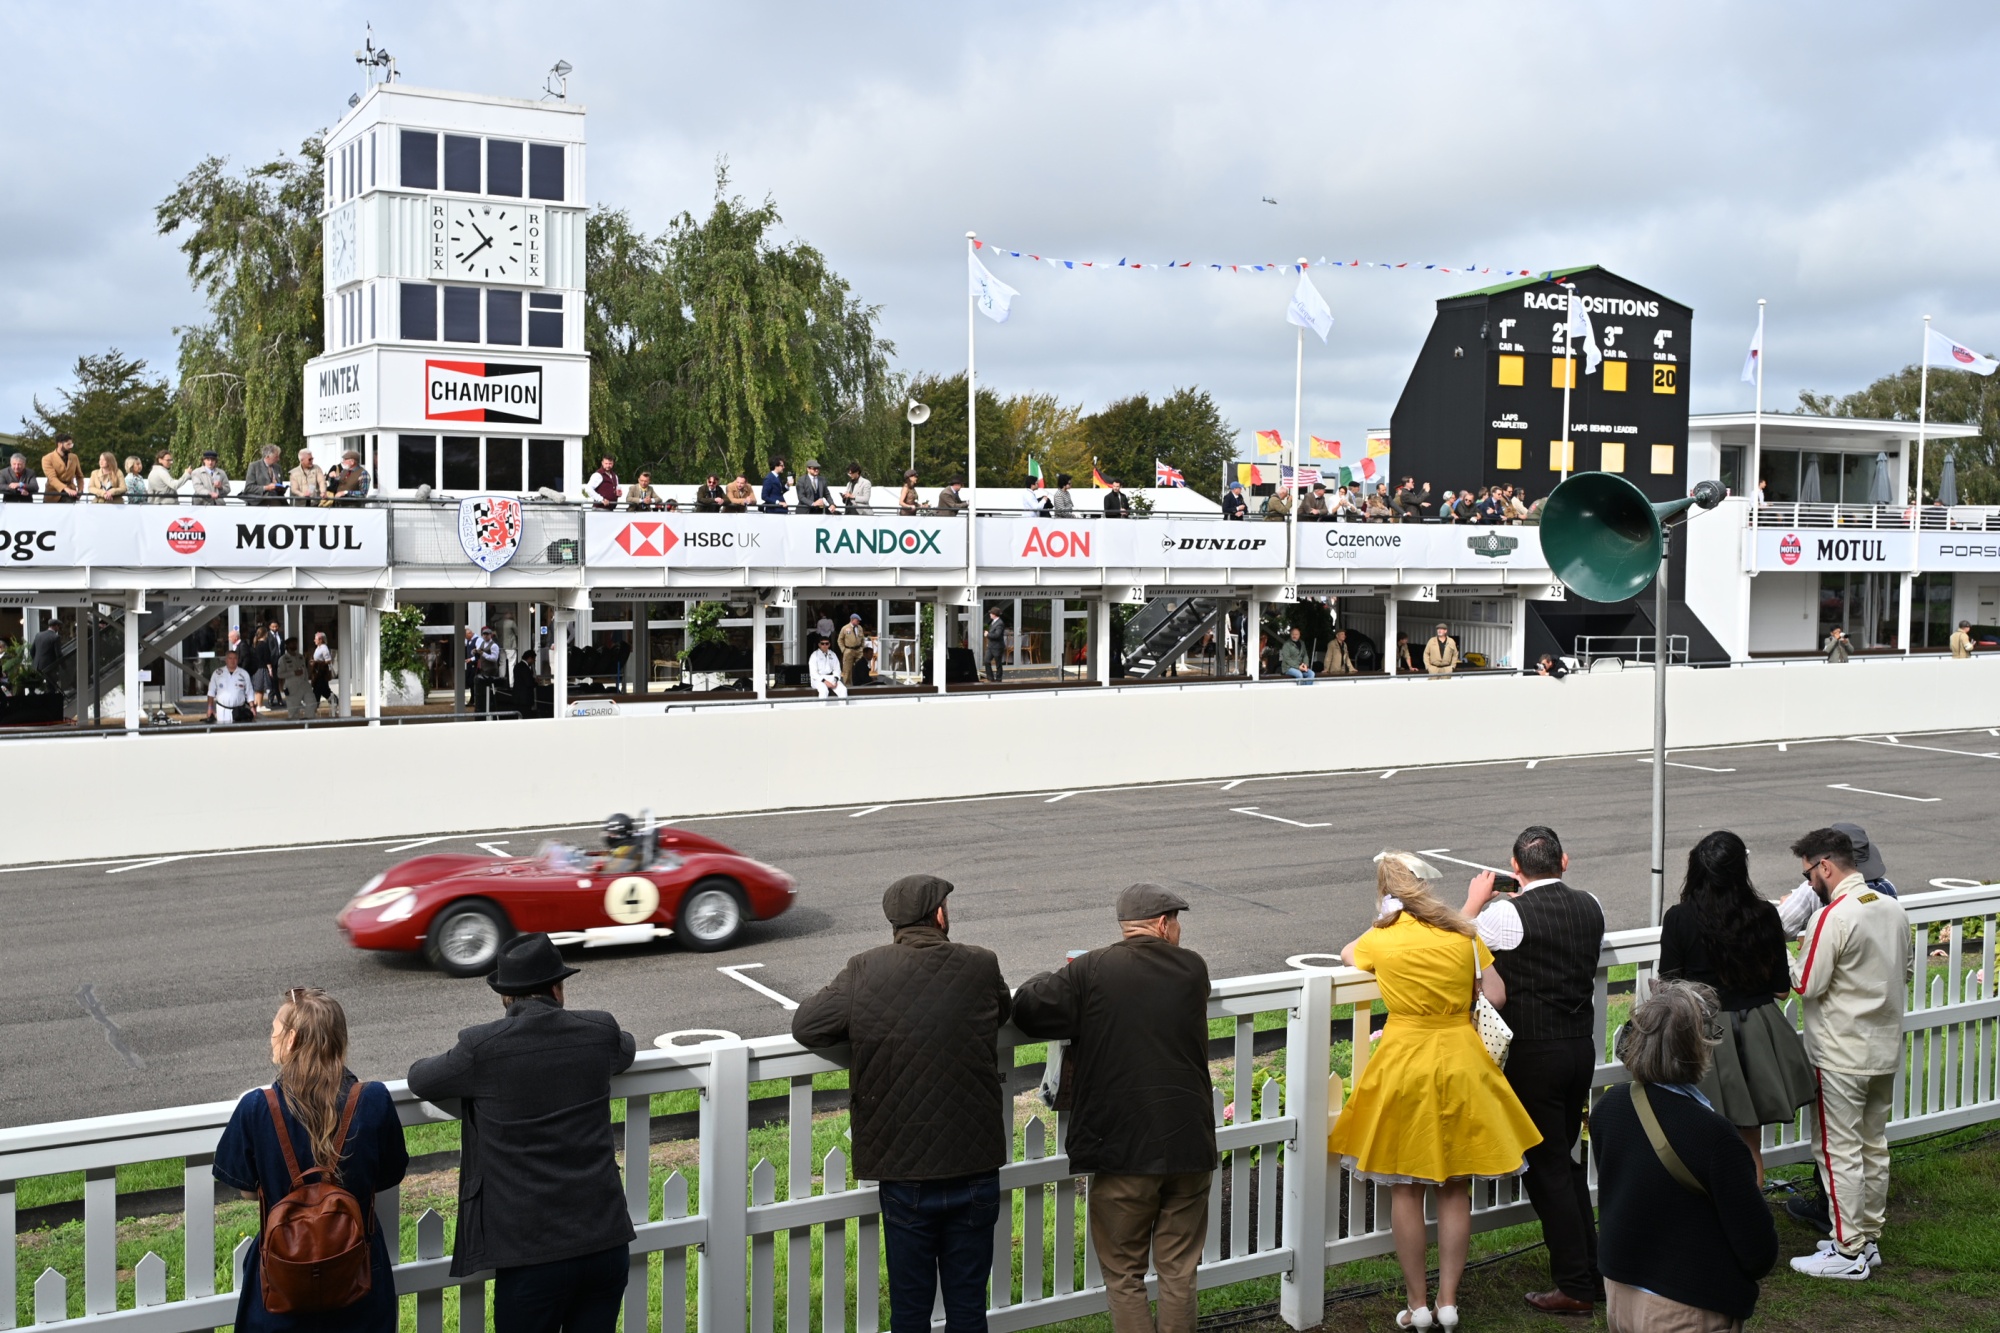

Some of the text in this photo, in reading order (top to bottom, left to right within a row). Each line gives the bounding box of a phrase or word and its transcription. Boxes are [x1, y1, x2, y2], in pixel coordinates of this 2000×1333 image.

[433, 205, 444, 271] ROLEX
[528, 214, 540, 278] ROLEX
[1524, 292, 1568, 311] RACE
[1499, 342, 1512, 351] CAR
[1552, 346, 1565, 354] CAR
[1604, 349, 1616, 358] CAR
[1654, 352, 1666, 361] CAR
[319, 364, 360, 398] MINTEX
[1654, 369, 1676, 387] 20
[430, 380, 537, 404] CHAMPION
[319, 402, 360, 423] BRAKE LINERS
[1492, 421, 1528, 430] COMPLETED
[1571, 424, 1638, 434] LAPS BEHIND LEADER
[462, 504, 475, 550] BARC
[169, 532, 204, 540] MOTUL
[236, 524, 362, 550] MOTUL
[684, 532, 760, 548] HSBC UK
[816, 528, 942, 554] RANDOX
[1022, 526, 1090, 558] AON
[1326, 530, 1402, 548] Cazenove
[1178, 538, 1266, 550] DUNLOP
[1817, 538, 1886, 562] MOTUL
[1940, 545, 2000, 557] PORS
[1326, 550, 1356, 560] Capital
[782, 588, 791, 603] 20
[966, 589, 975, 602] 21
[1132, 588, 1142, 600] 22
[1284, 587, 1295, 600] 23
[1422, 586, 1434, 598] 24
[1550, 586, 1562, 597] 25
[622, 882, 644, 914] 4
